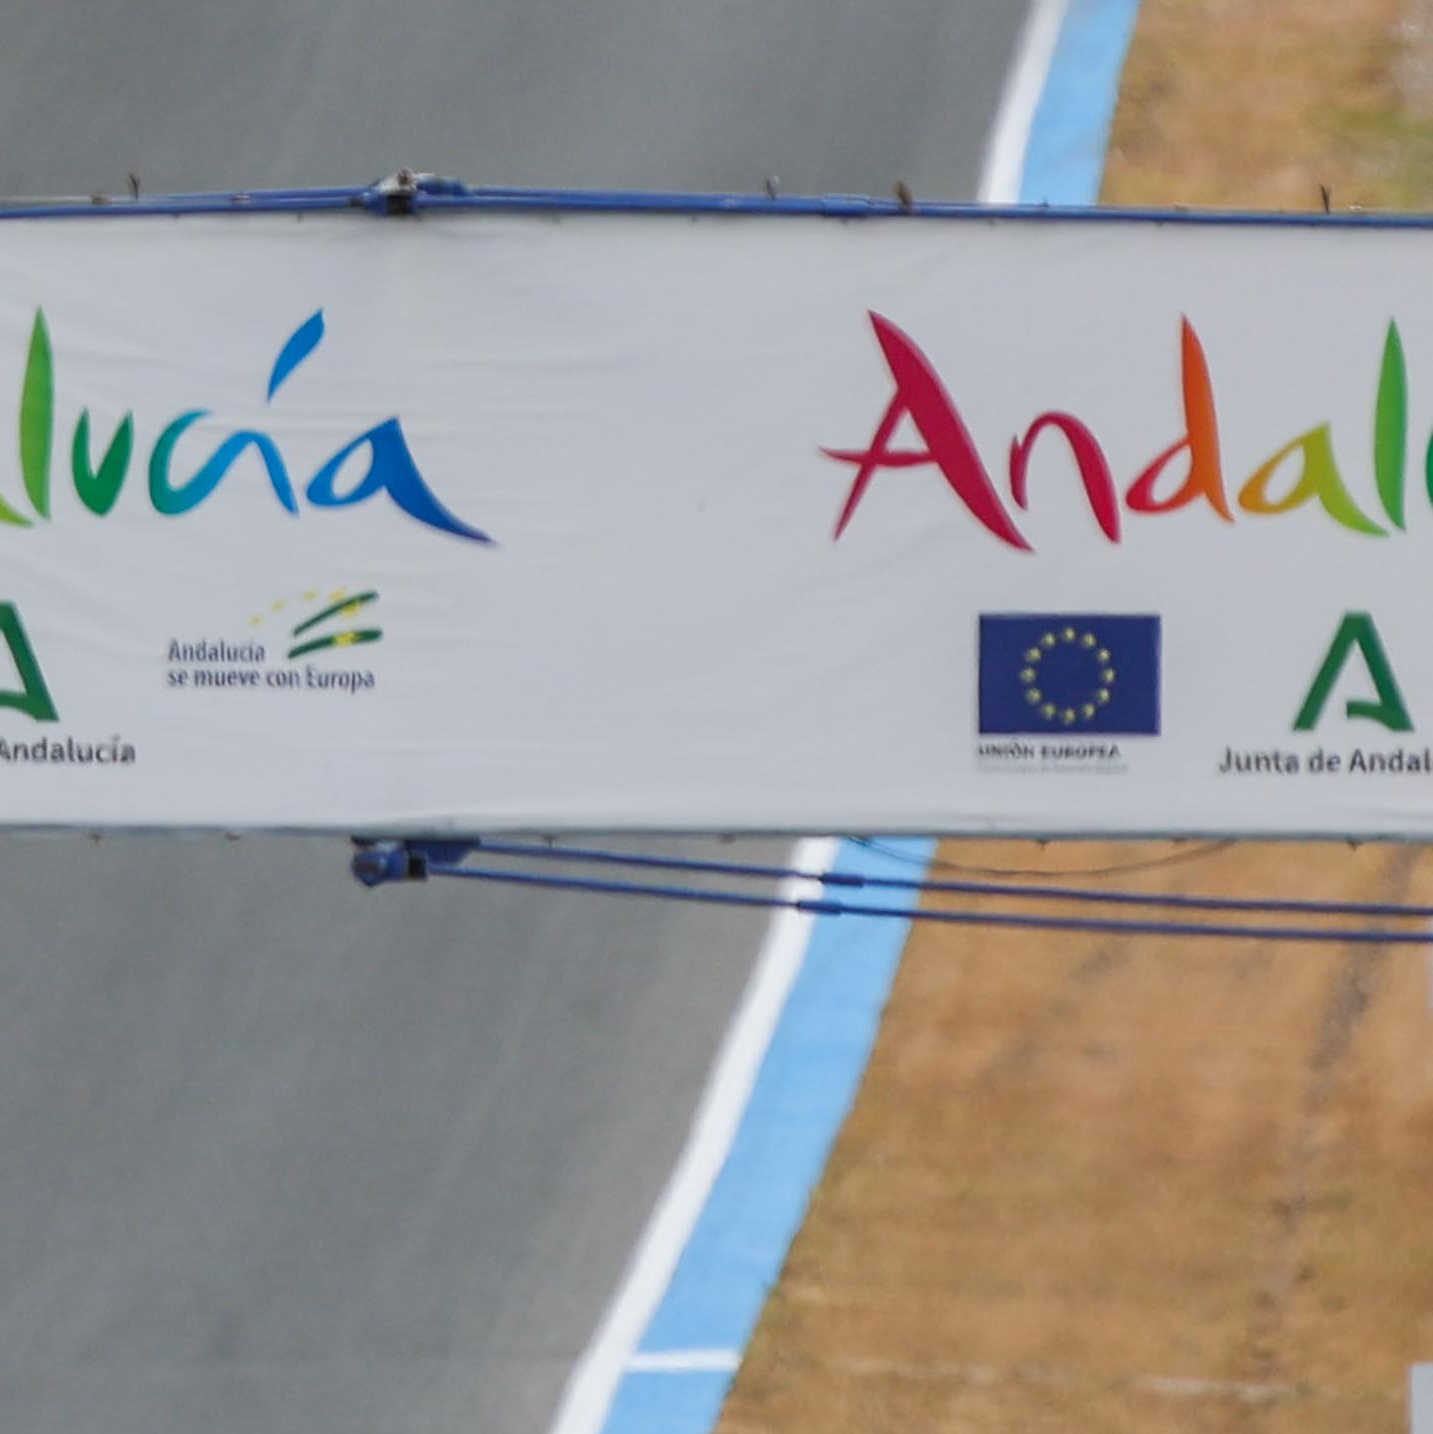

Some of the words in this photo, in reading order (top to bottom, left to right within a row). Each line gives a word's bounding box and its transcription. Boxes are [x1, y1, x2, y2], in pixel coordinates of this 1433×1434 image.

[821, 310, 1433, 553] Andal
[1218, 748, 1299, 774] Junta
[1308, 748, 1342, 774] de
